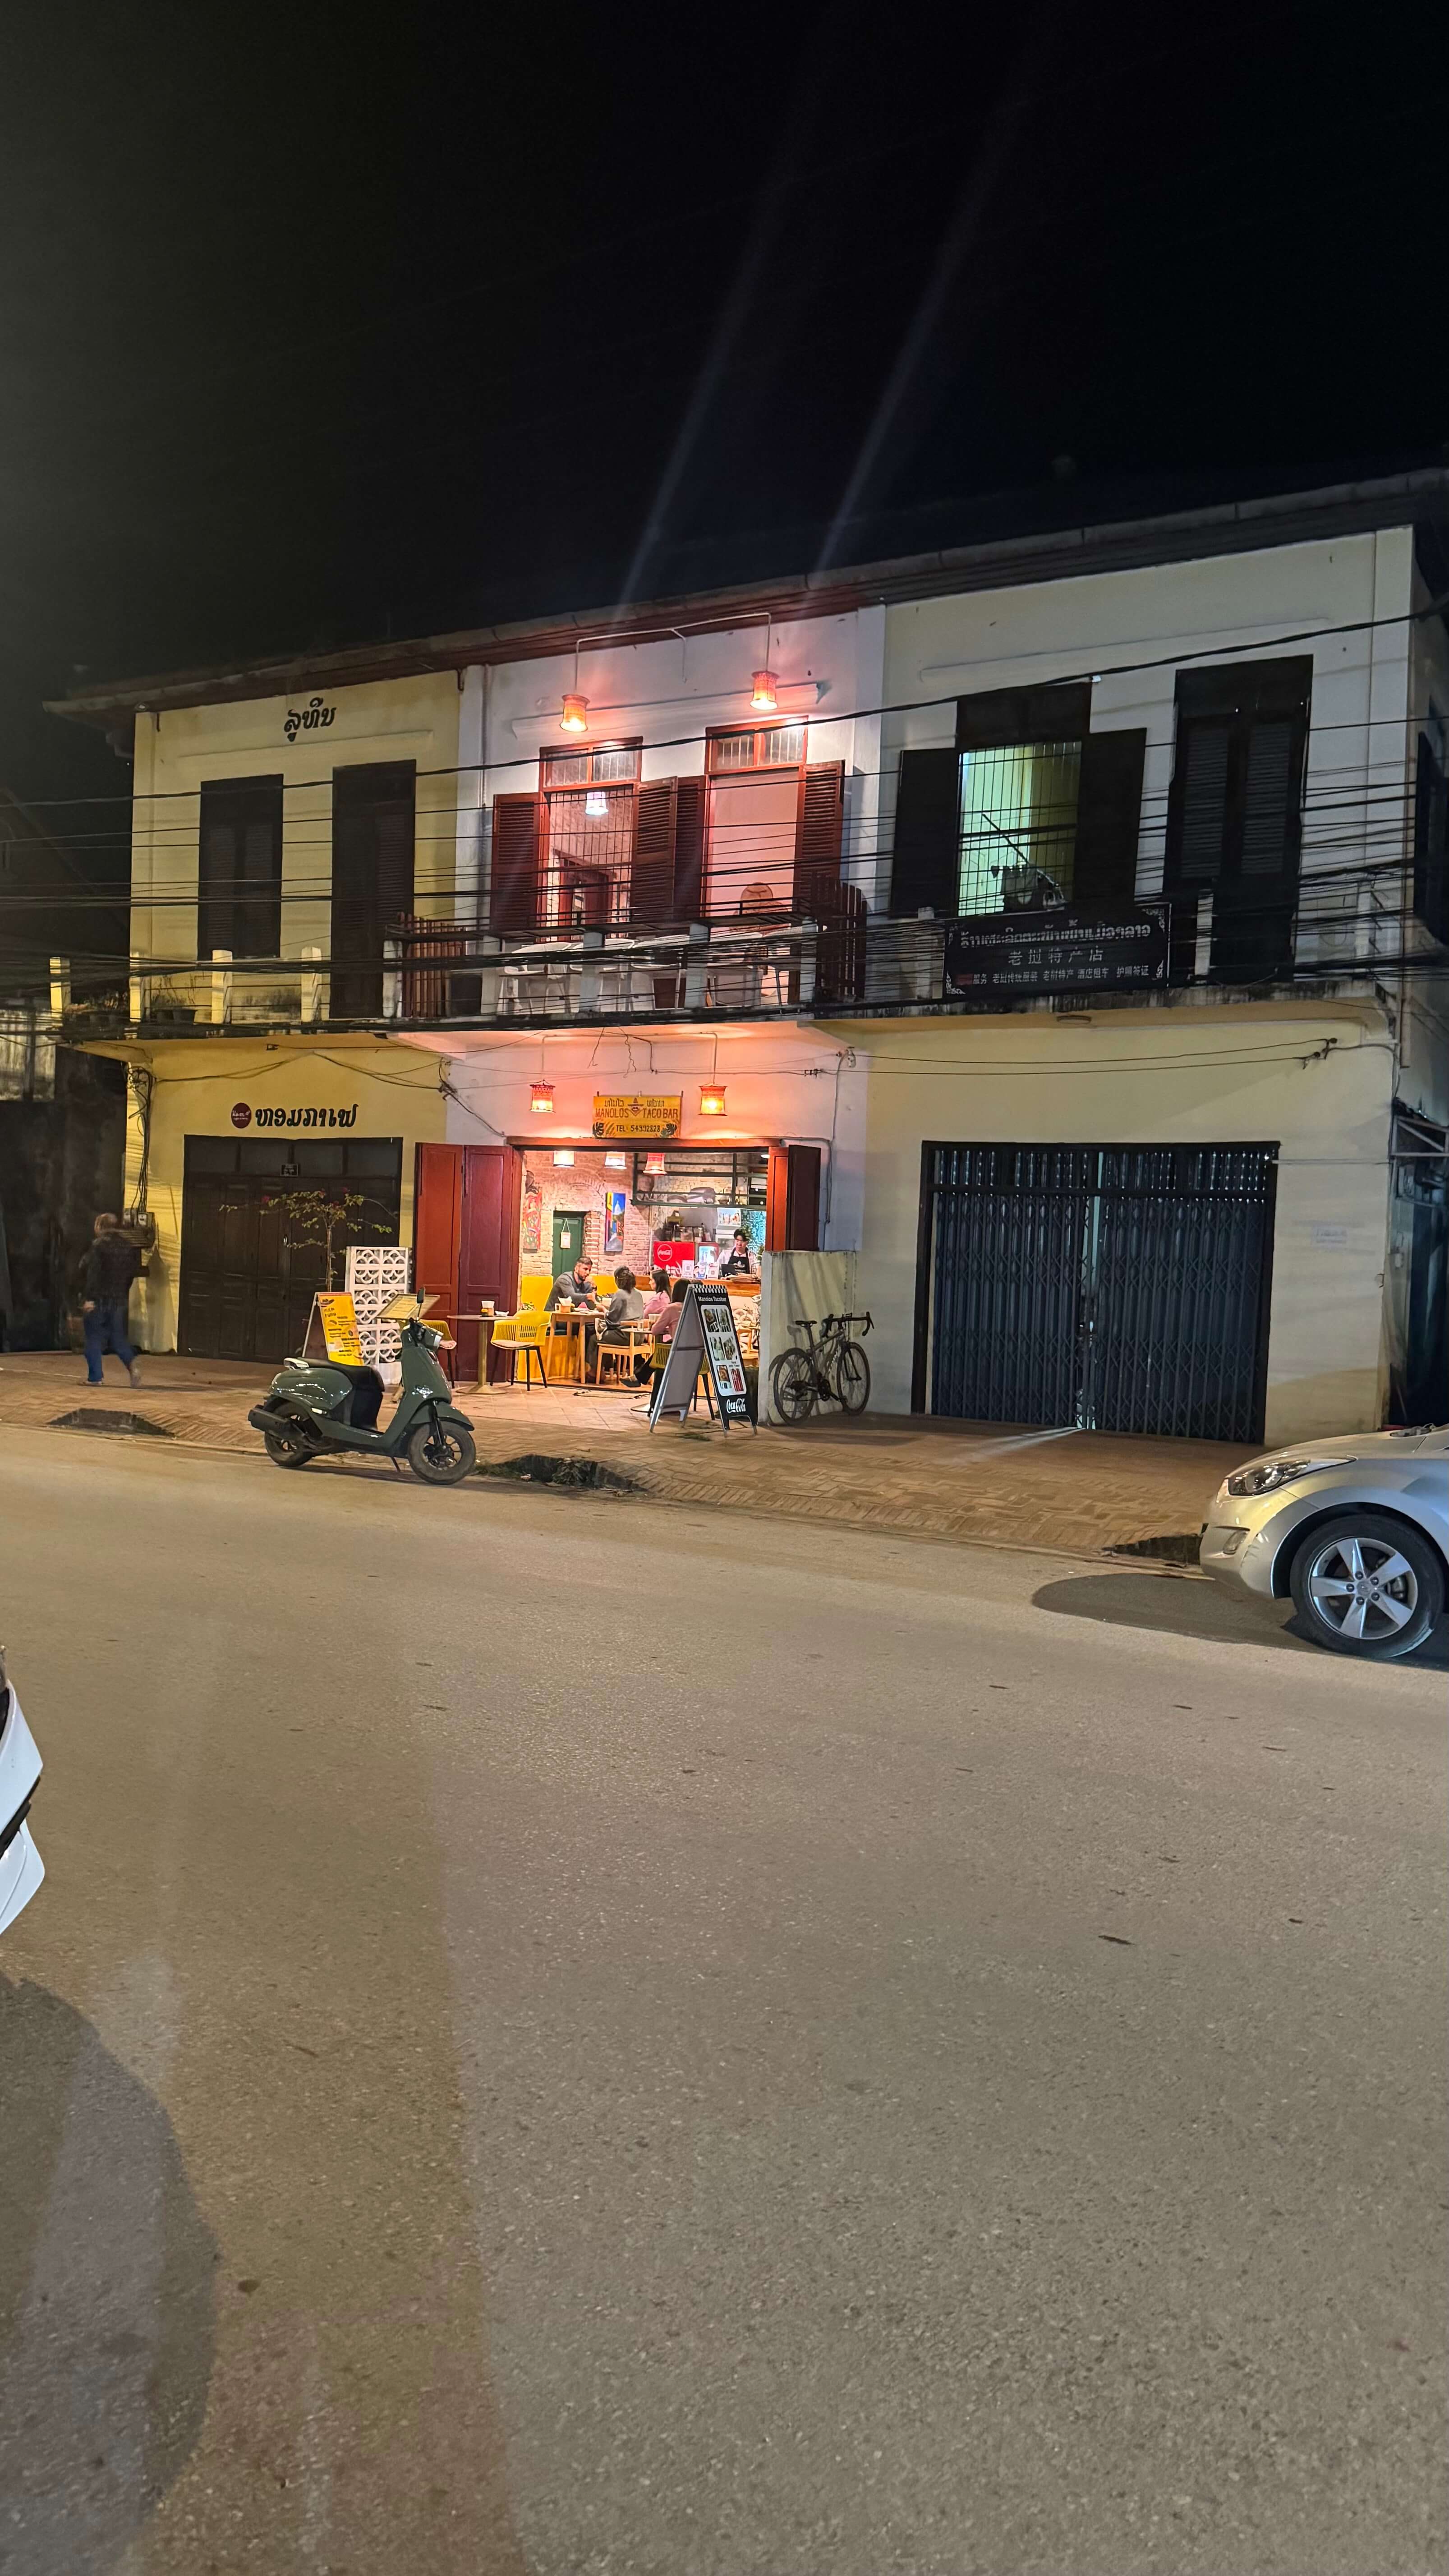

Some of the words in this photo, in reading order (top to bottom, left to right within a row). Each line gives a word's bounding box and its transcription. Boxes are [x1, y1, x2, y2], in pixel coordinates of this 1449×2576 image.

[595, 1108, 629, 1118] MANOLOS
[643, 1109, 661, 1118] TACO
[663, 1109, 678, 1118] BAR
